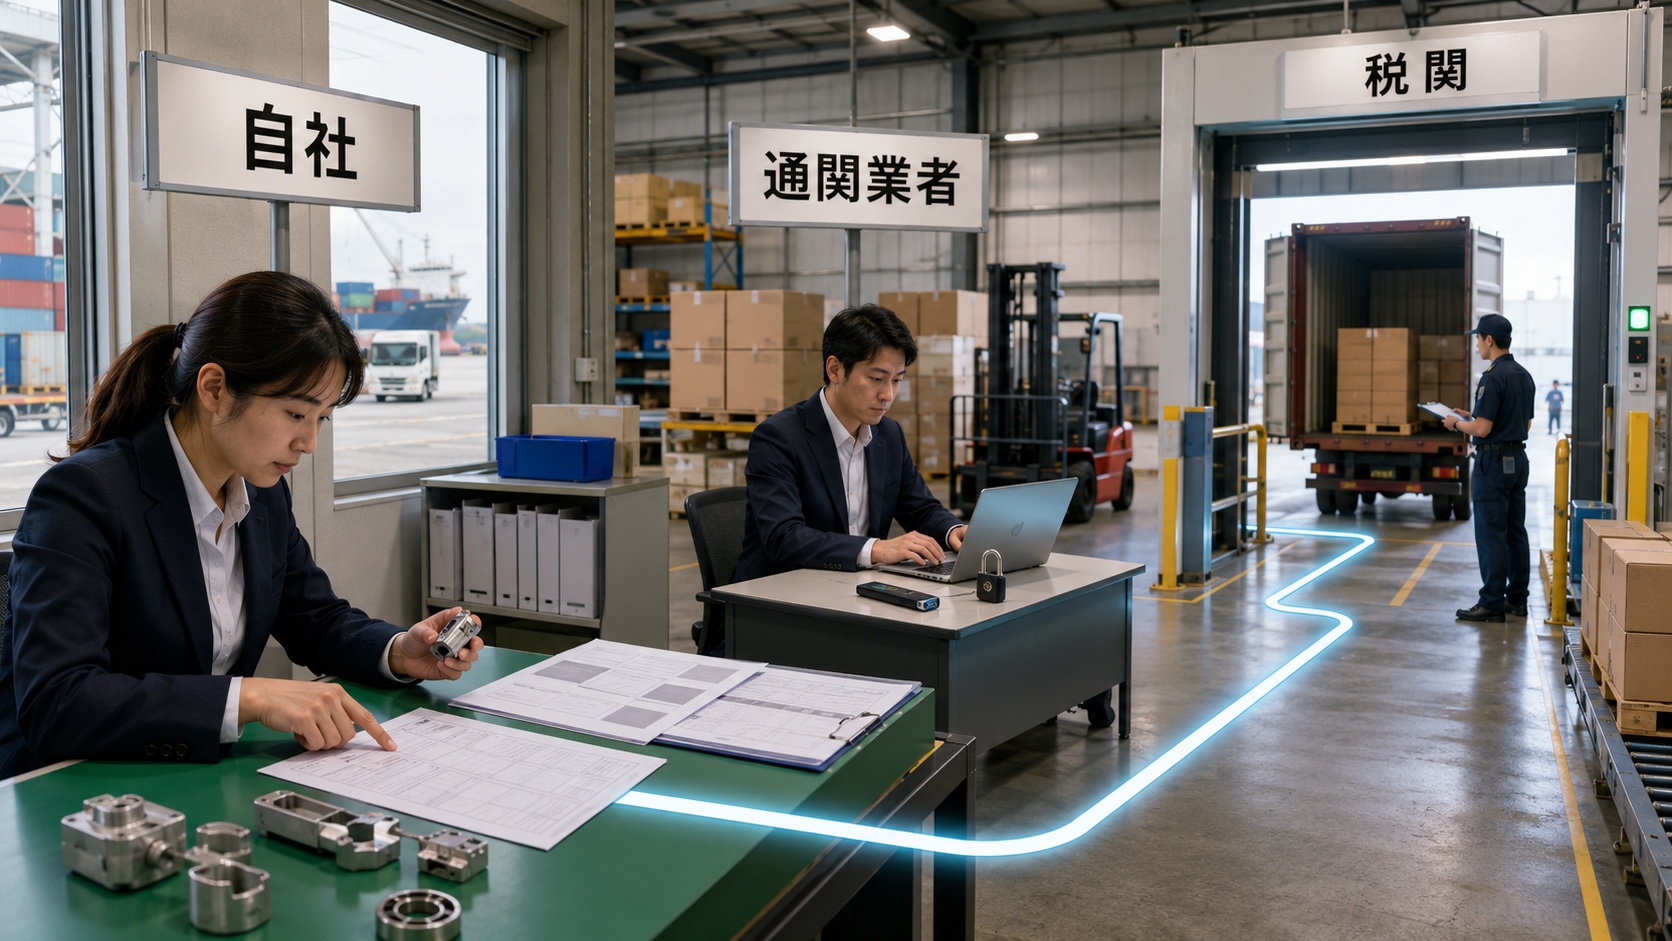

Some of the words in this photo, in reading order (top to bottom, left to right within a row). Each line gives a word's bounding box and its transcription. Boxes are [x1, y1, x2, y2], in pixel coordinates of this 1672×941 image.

[1365, 48, 1467, 97] 税関
[245, 102, 358, 180] 自社
[763, 150, 961, 206] 通関業者
